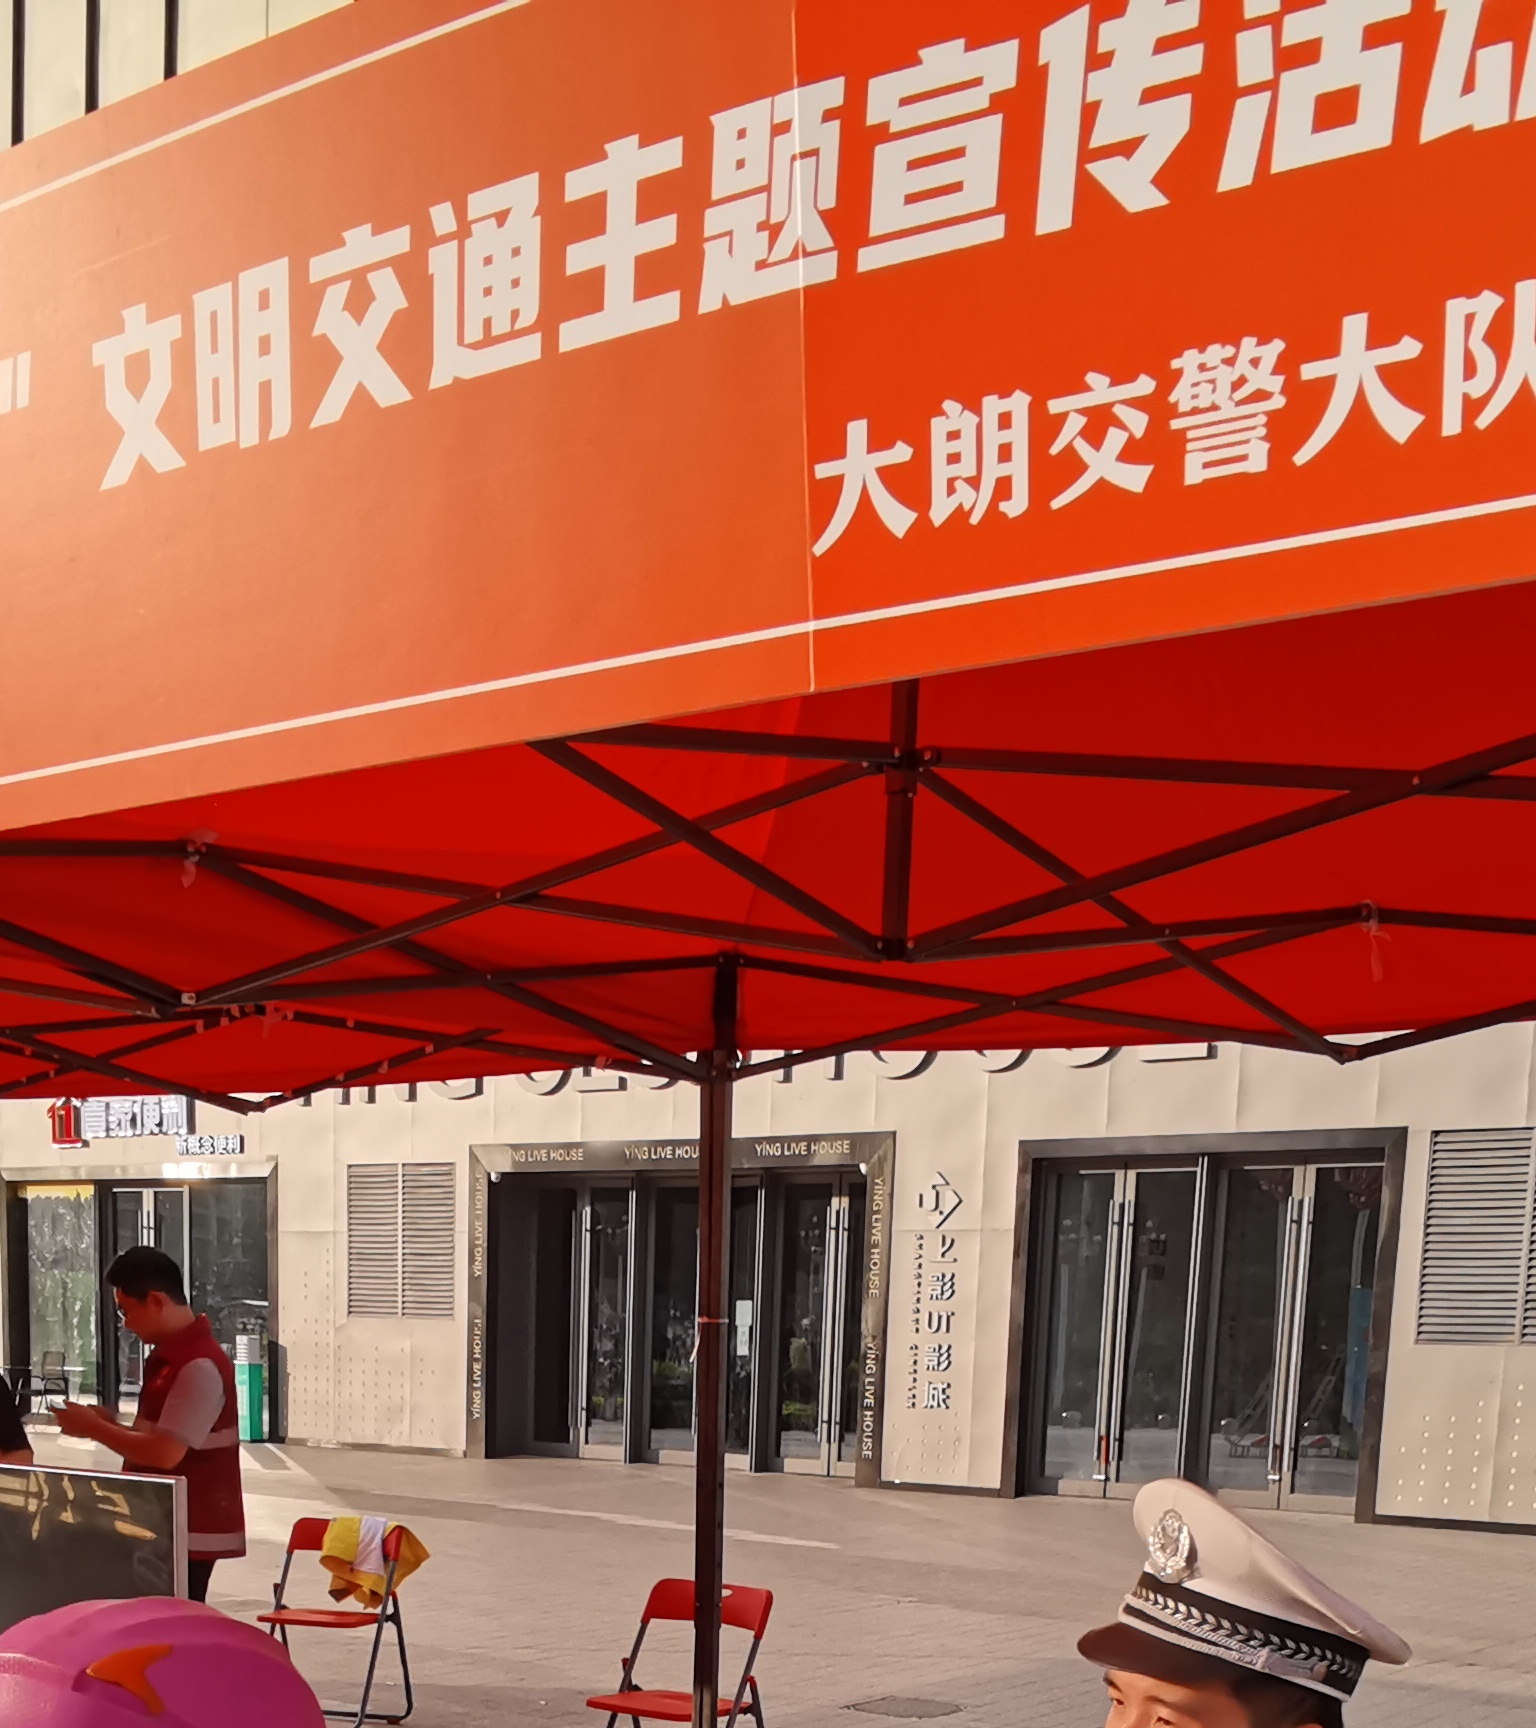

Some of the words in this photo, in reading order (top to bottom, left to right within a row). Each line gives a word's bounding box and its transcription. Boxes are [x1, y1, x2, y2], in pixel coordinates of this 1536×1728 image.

[527, 1148, 549, 1162] LIVE
[550, 1148, 584, 1161] HOUSE
[650, 1145, 673, 1160] LIVE
[783, 1142, 807, 1156] LIVE
[810, 1140, 851, 1155] HOUSE
[870, 1213, 883, 1245] LIVE
[867, 1247, 881, 1298] HOUSE
[473, 1360, 482, 1387] LIVE
[863, 1376, 876, 1408] LIVE
[861, 1408, 875, 1460] HOUSE
